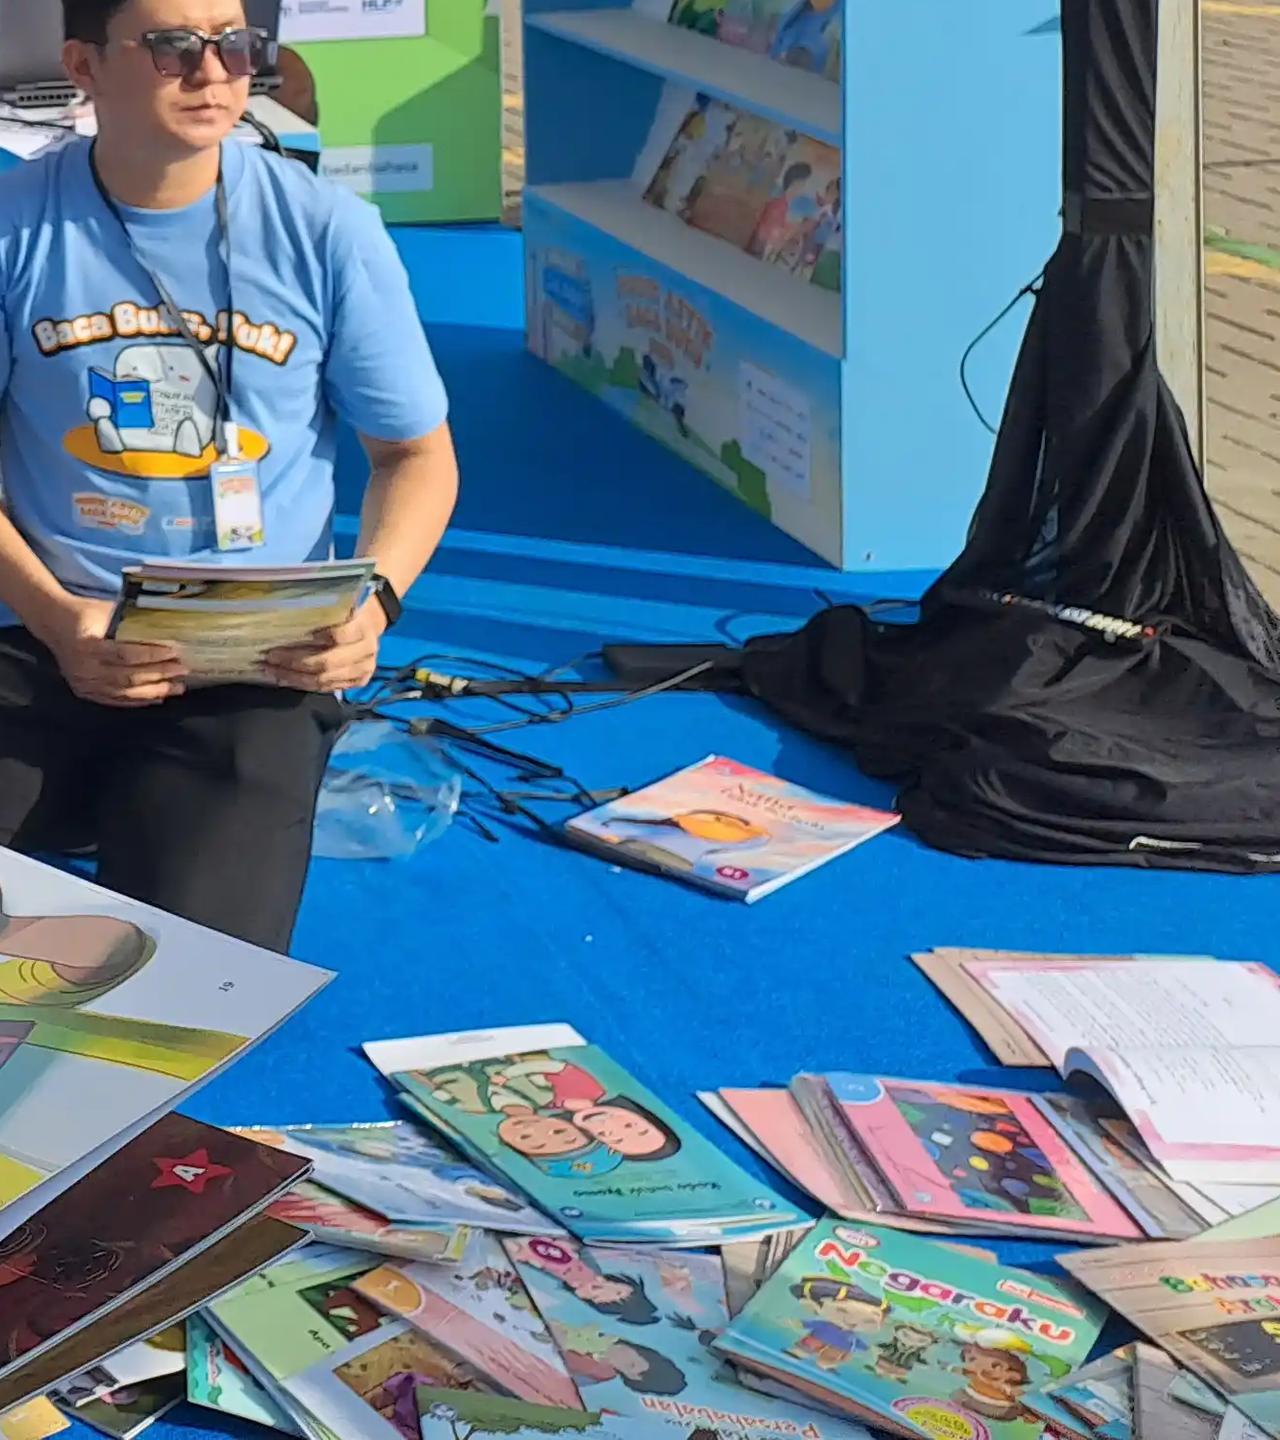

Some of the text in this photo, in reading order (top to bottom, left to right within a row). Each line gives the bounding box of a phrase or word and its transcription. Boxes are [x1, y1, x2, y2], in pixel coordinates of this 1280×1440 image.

[34, 312, 114, 355] Baca
[171, 1163, 209, 1183] A
[815, 1240, 1077, 1346] Negaraku
